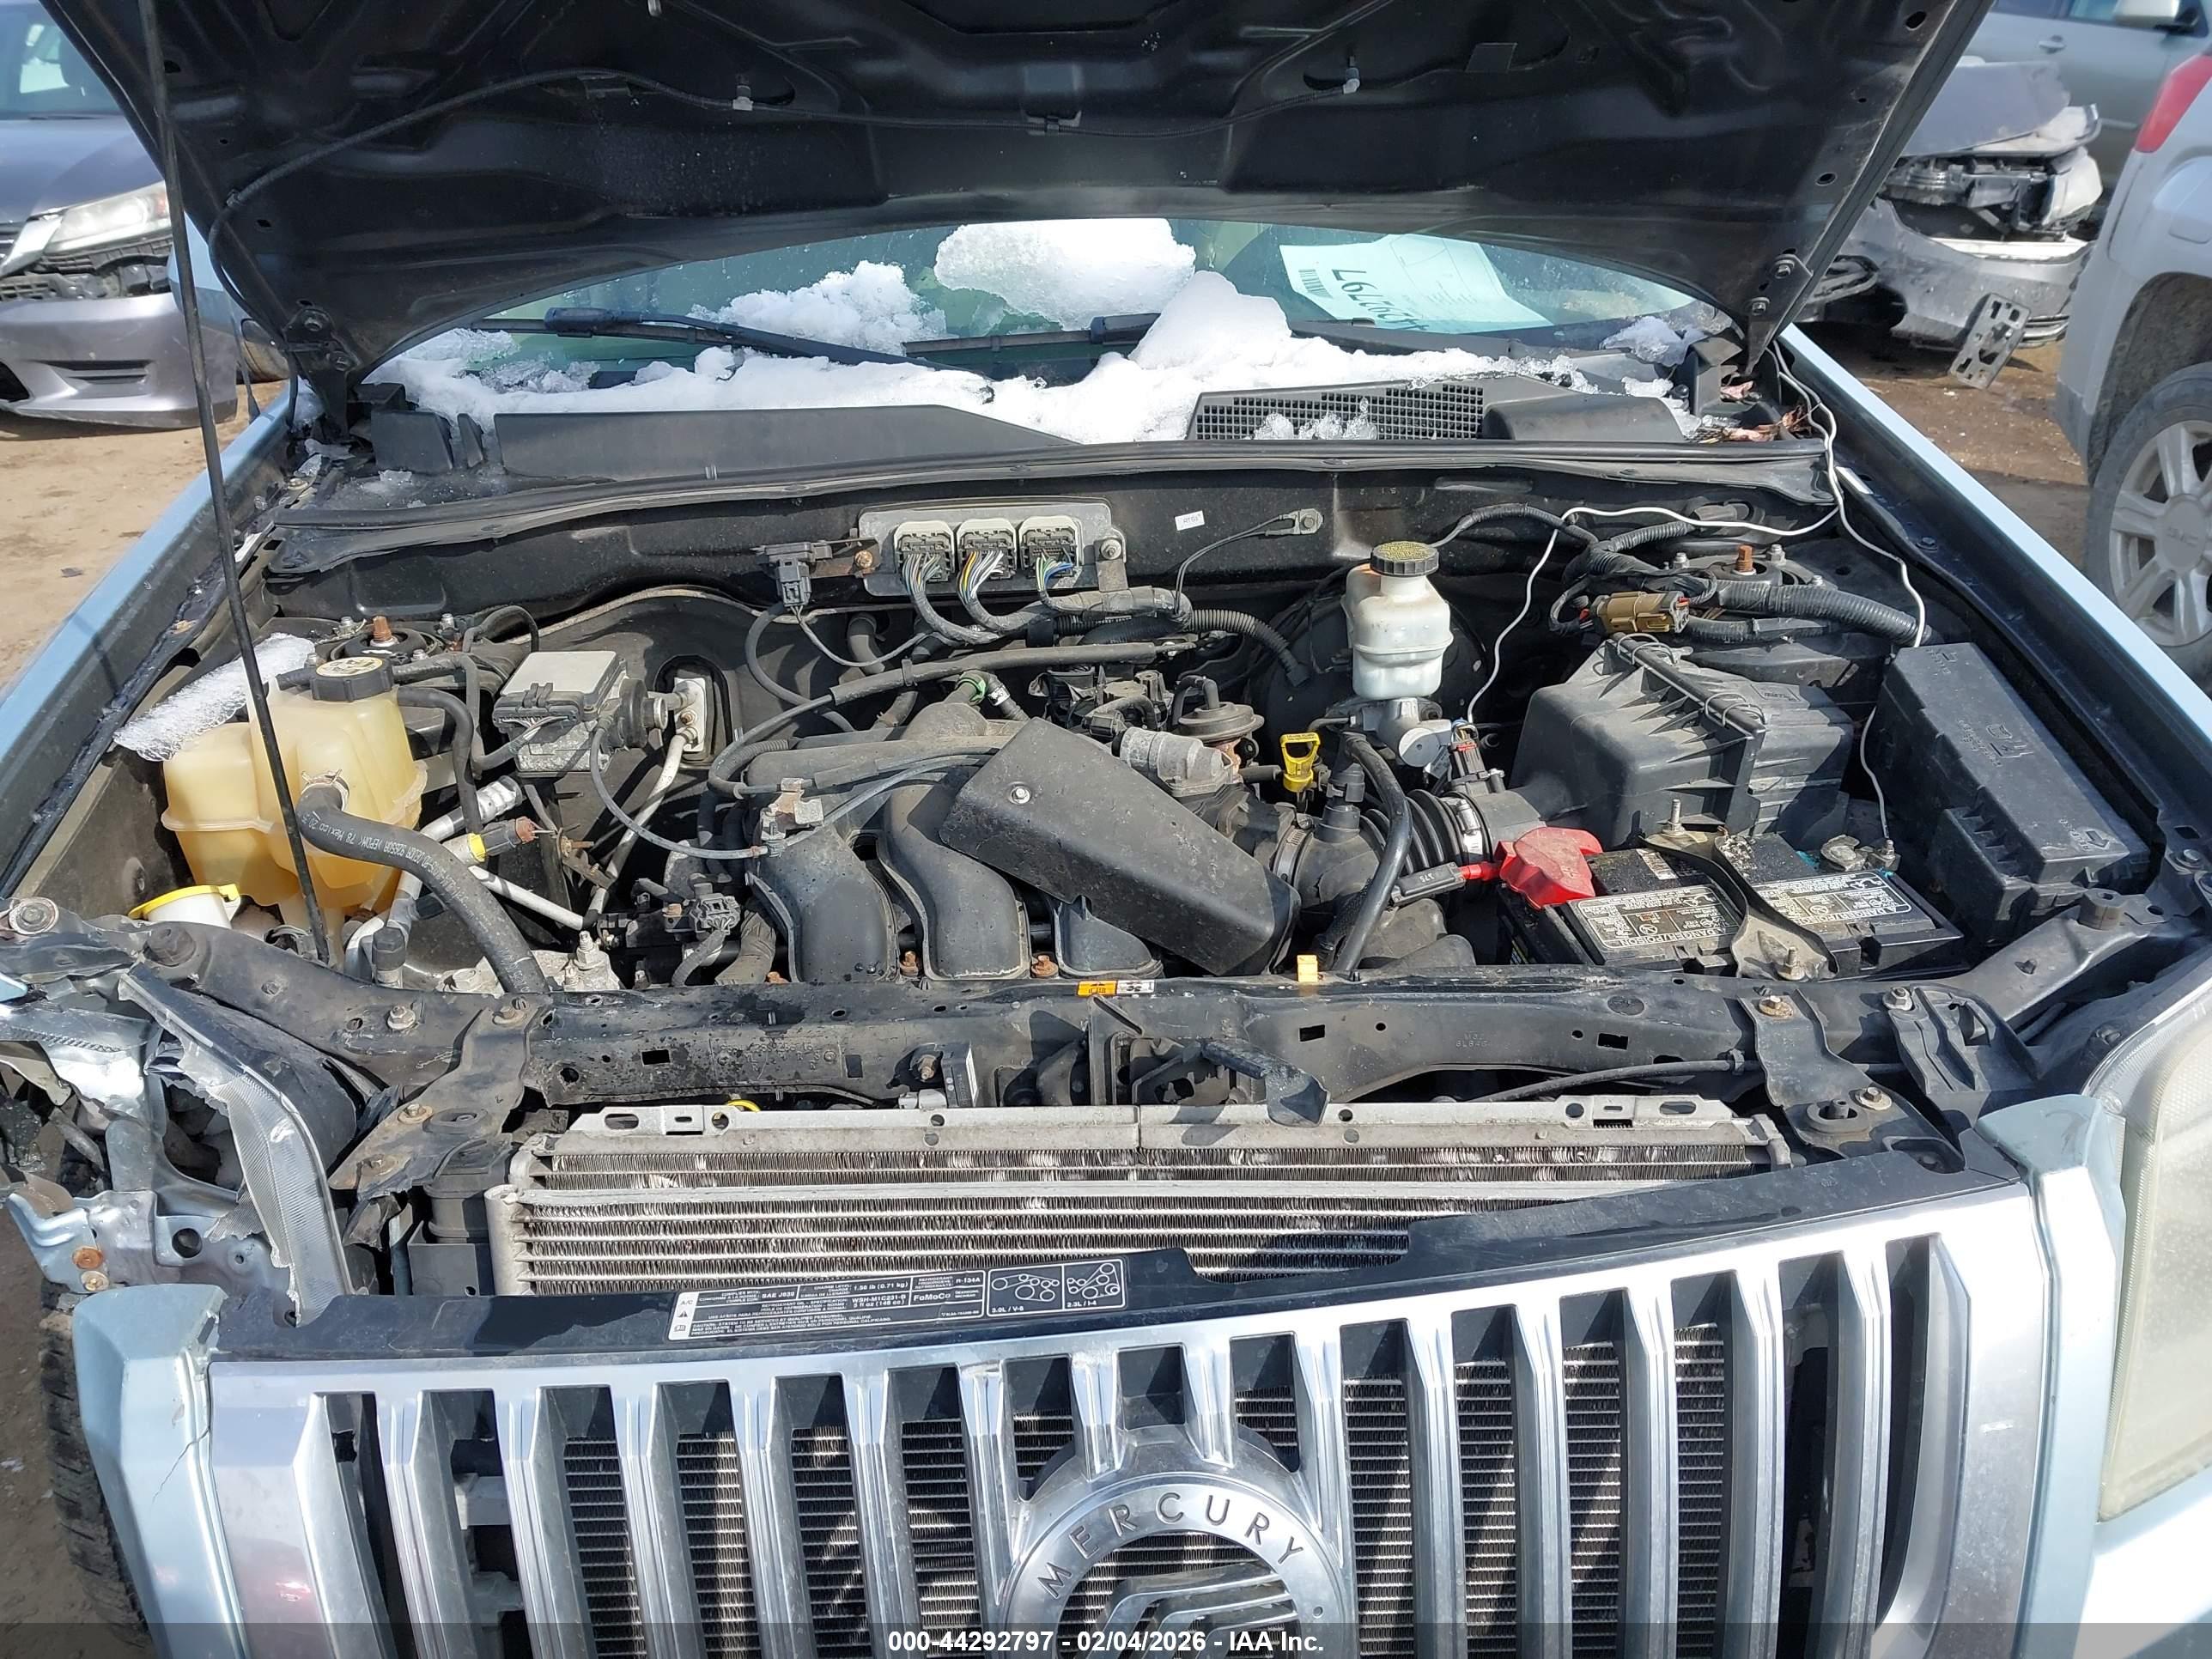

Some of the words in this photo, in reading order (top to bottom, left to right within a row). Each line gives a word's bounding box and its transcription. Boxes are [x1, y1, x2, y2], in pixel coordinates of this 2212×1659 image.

[319, 823, 344, 841] Mexico
[913, 1292, 951, 1301] FoMoCo
[1036, 1492, 1304, 1599] MERCURY
